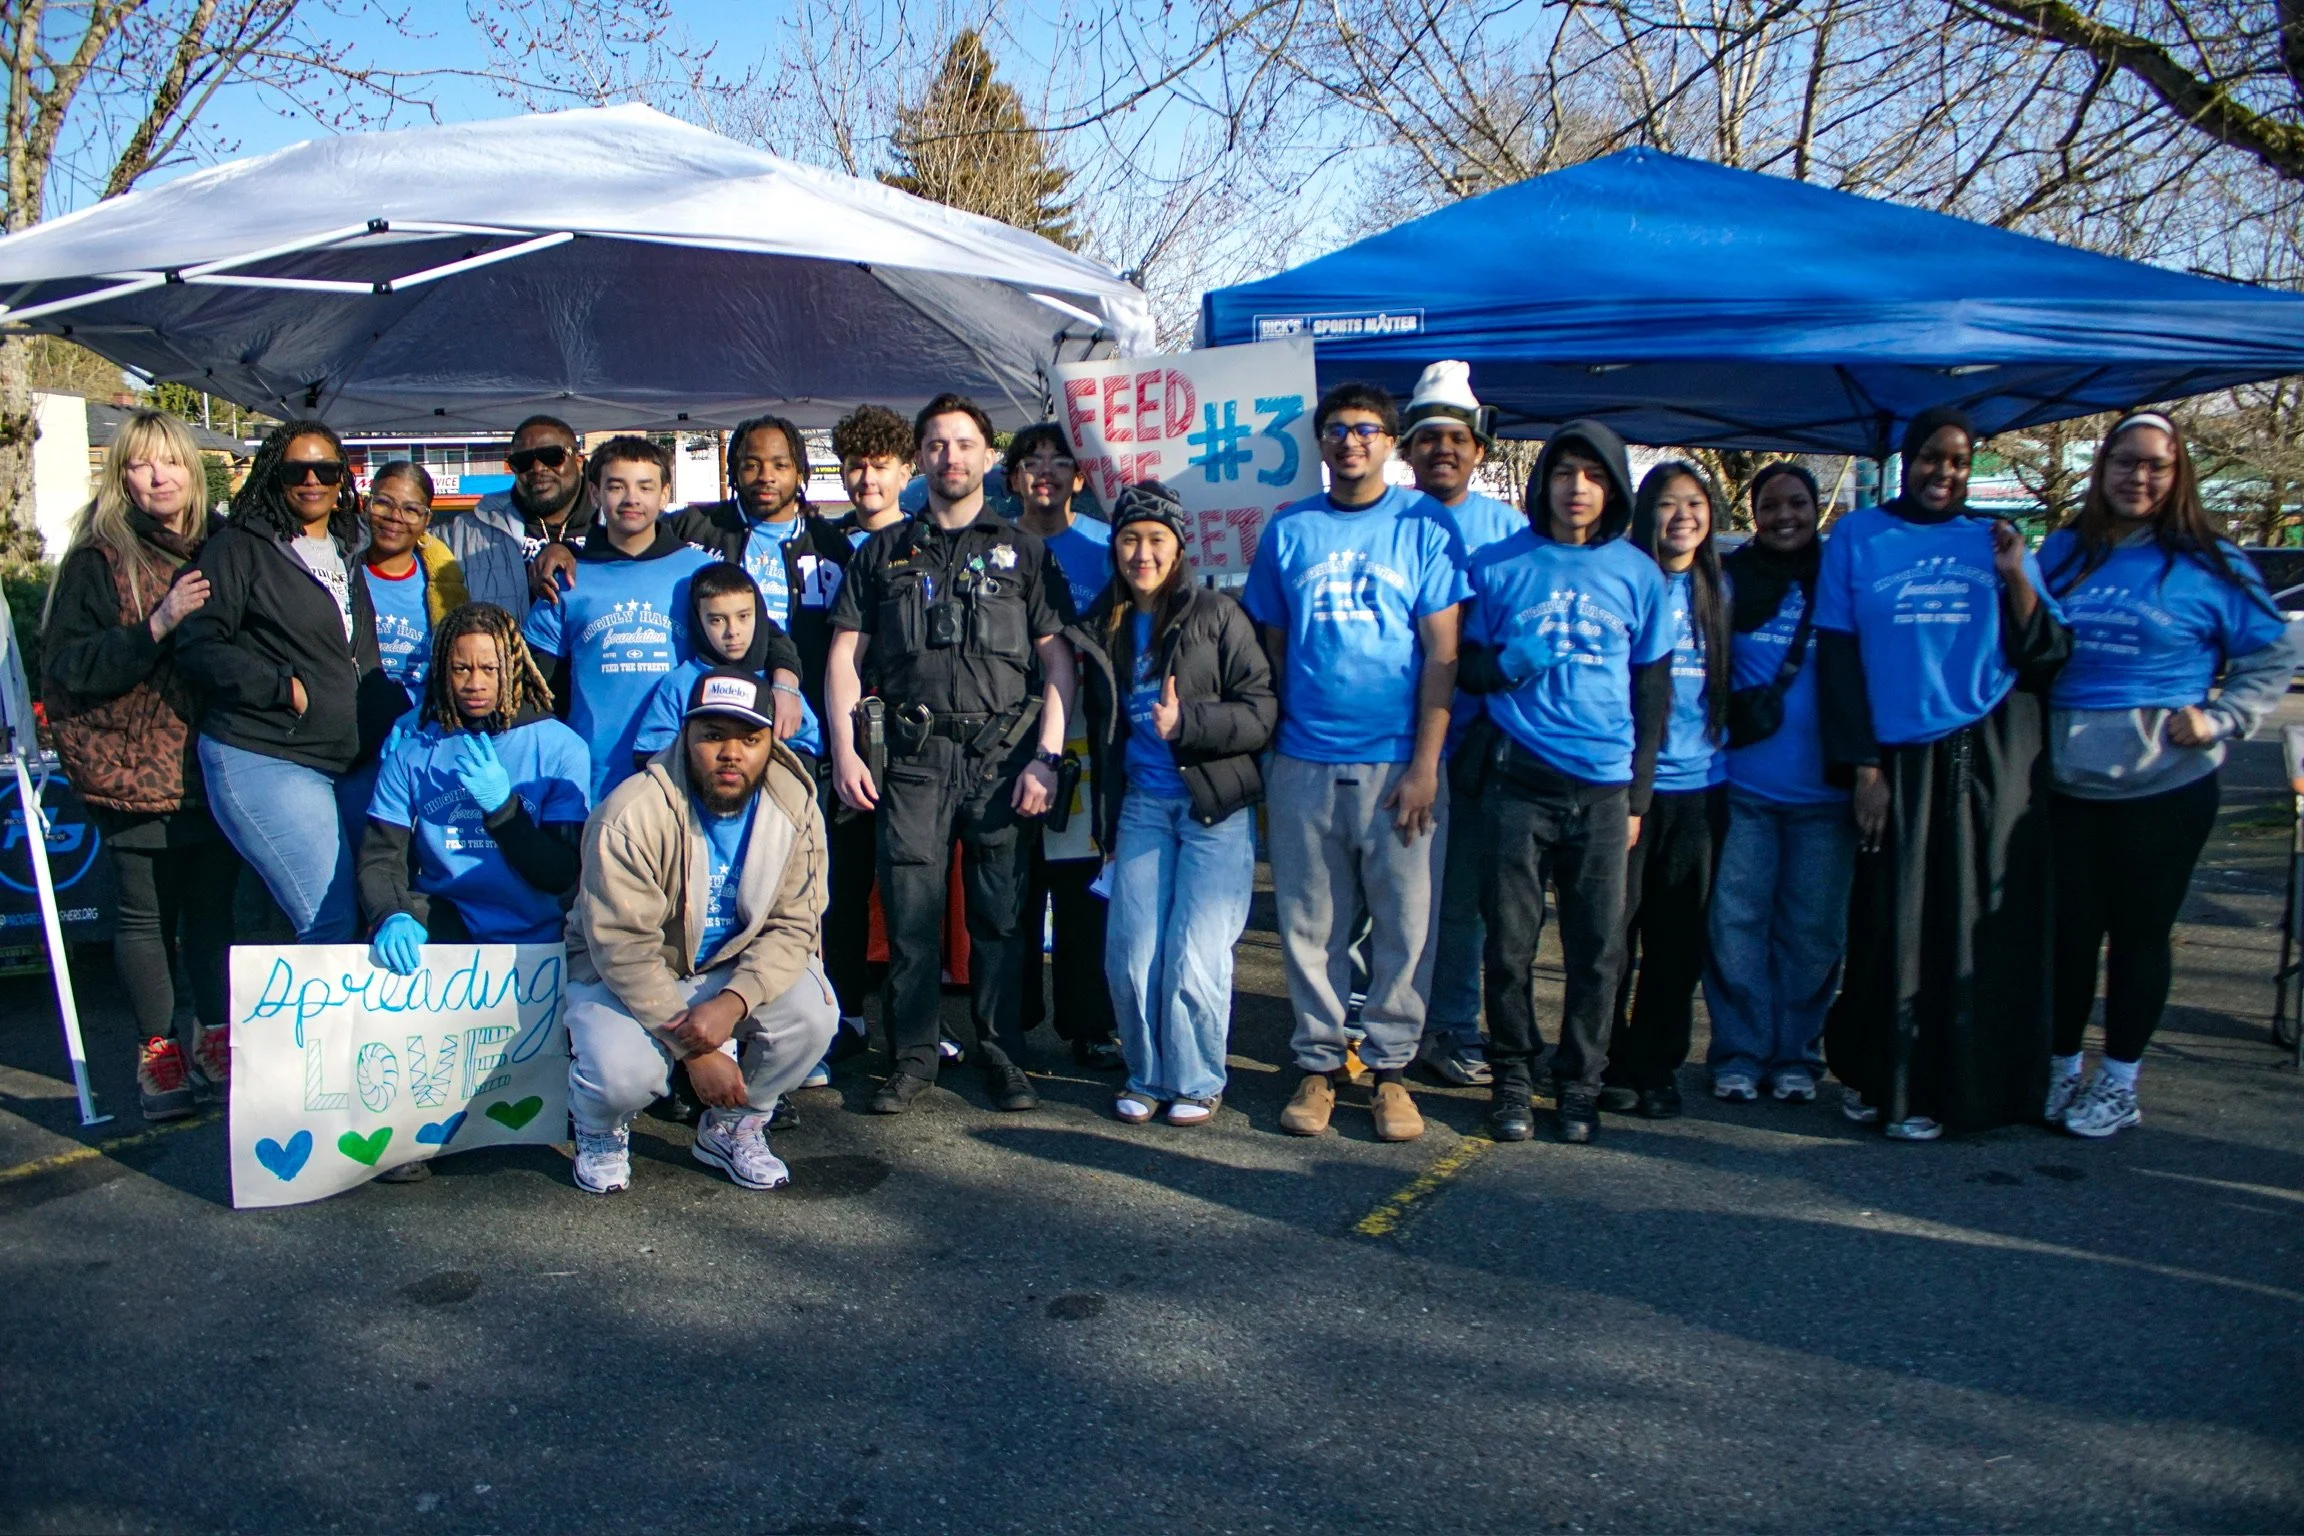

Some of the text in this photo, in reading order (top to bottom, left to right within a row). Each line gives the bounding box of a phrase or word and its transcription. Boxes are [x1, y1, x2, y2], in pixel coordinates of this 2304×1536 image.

[1262, 313, 1418, 335] DICK'S SPORTS MATTER
[1064, 368, 1197, 448] FEED
[1187, 394, 1305, 487] #3
[433, 477, 458, 487] VICE
[1078, 450, 1162, 500] THE
[581, 610, 634, 644] HIGHLY
[602, 626, 667, 650] foundation
[602, 662, 670, 673] FEED THE STREETS
[711, 682, 746, 698] Modelo
[467, 840, 484, 849] THE
[243, 948, 561, 1064] Spreading
[304, 1026, 517, 1113] LOVE
